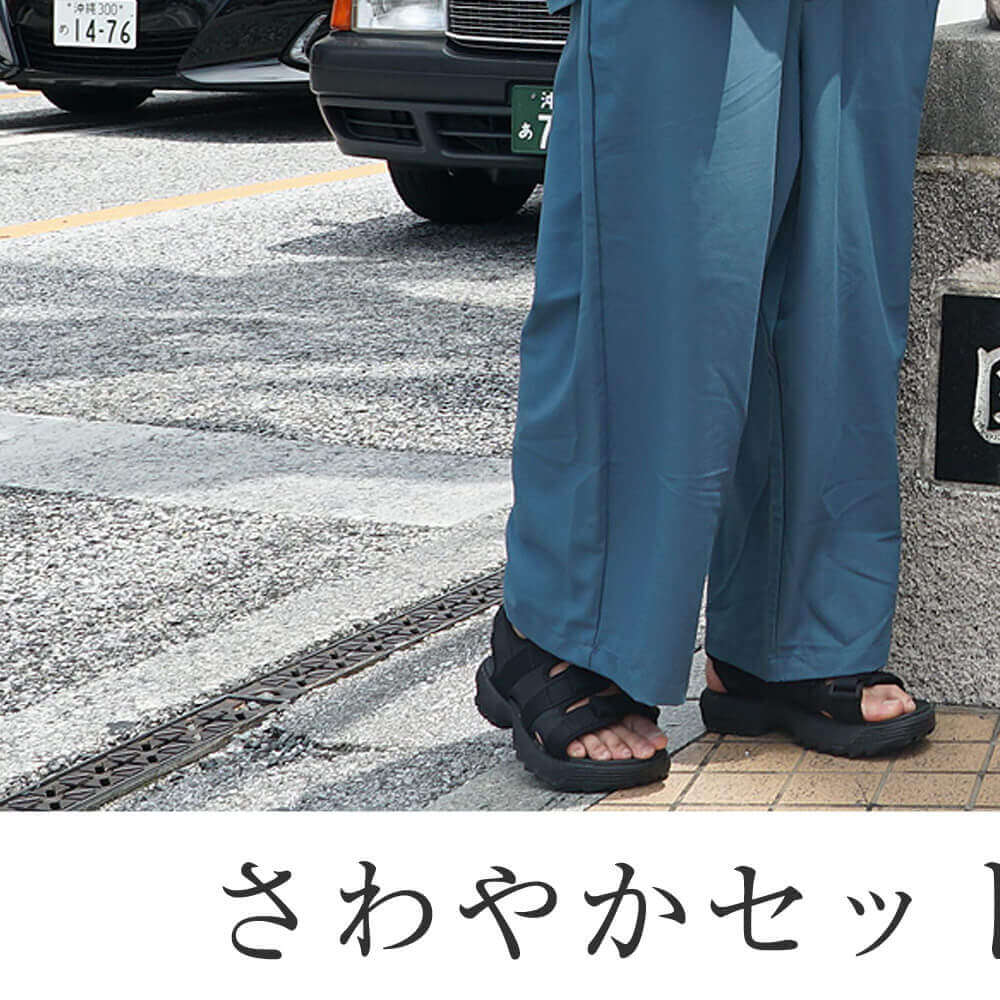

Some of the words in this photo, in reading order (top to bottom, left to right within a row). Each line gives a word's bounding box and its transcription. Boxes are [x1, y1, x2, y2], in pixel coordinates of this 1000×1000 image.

[98, 3, 118, 16] 300
[75, 18, 131, 44] 14-76
[518, 122, 534, 140] あ
[538, 114, 553, 150] 7
